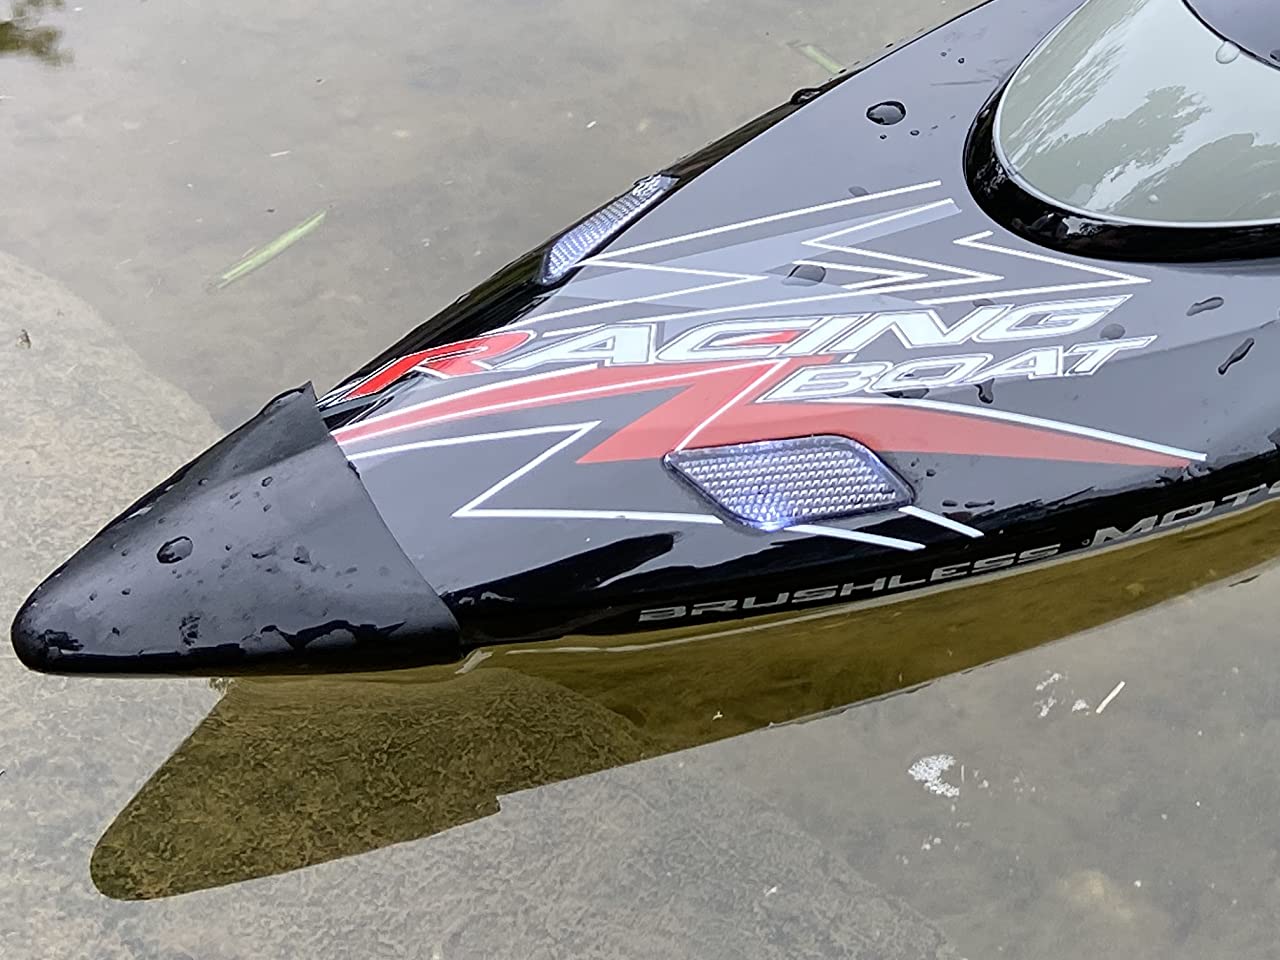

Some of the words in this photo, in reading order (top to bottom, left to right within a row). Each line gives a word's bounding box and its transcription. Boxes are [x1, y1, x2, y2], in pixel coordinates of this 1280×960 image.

[330, 294, 1134, 404] RACING
[758, 336, 1156, 403] BOAT
[638, 544, 1061, 623] BRUSHLESS
